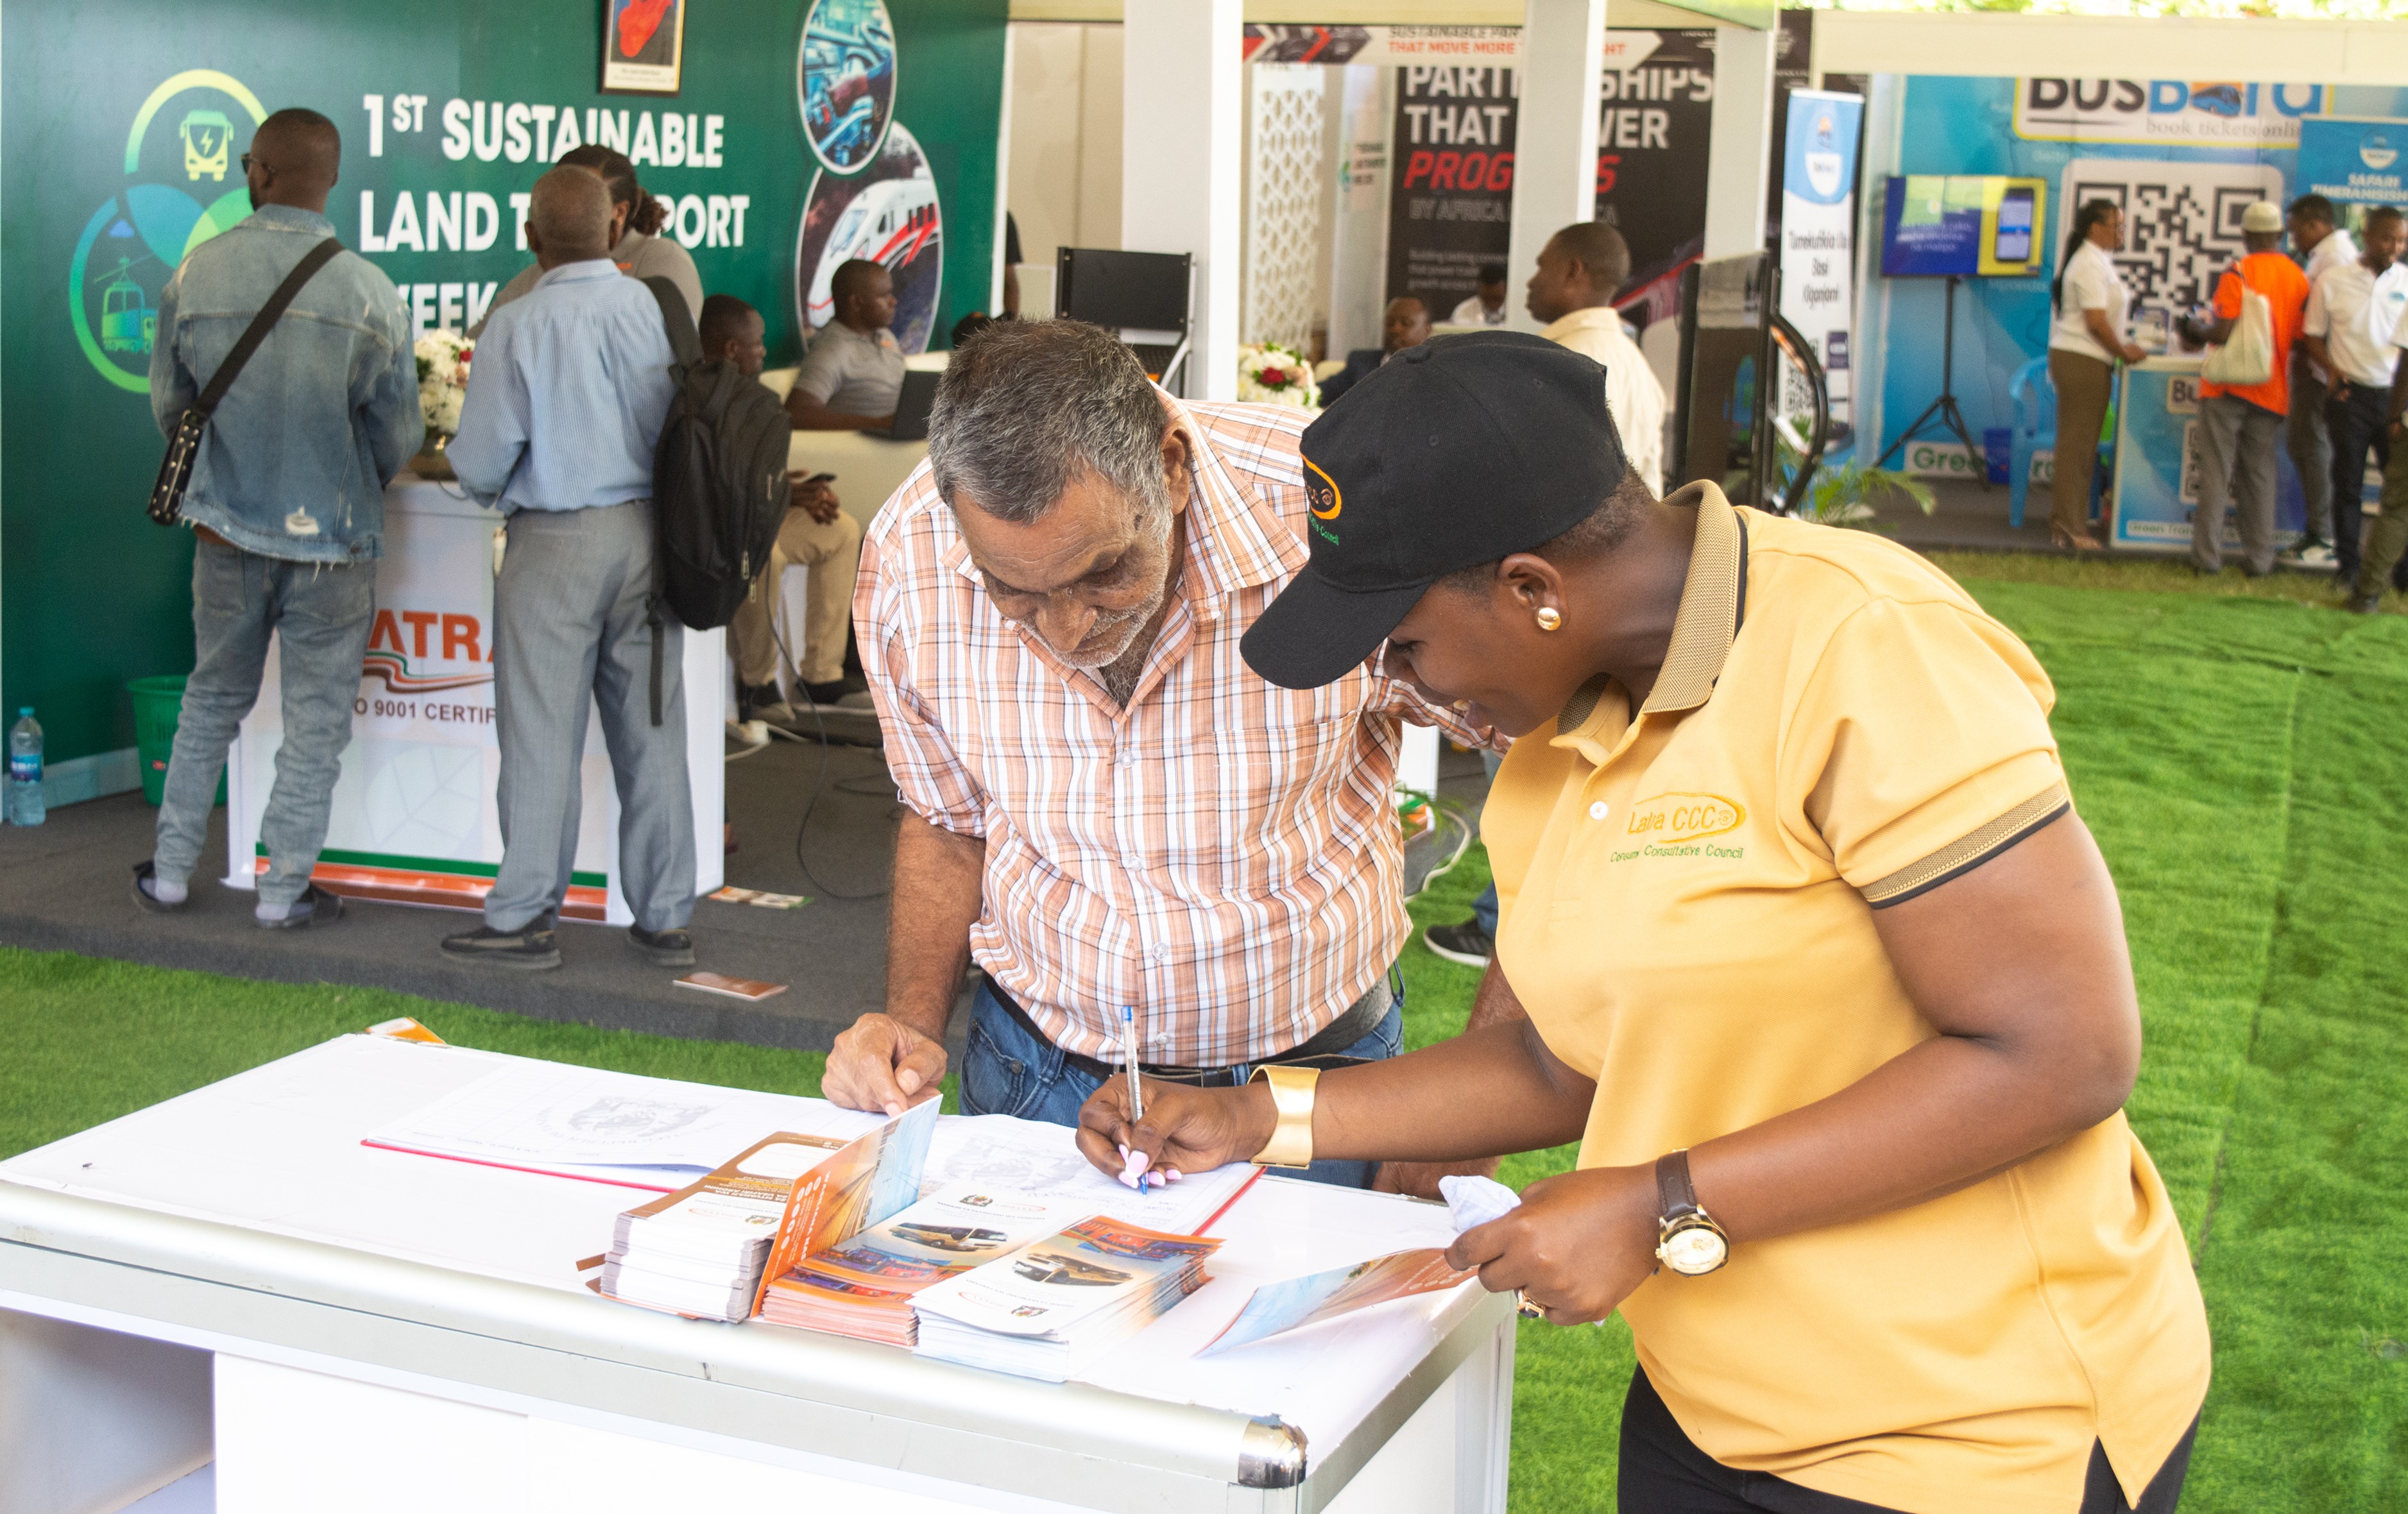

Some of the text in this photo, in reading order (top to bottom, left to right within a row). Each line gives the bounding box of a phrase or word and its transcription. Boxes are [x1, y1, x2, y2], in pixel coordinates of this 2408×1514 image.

[1388, 42, 1515, 54] THAT MOVE MORE
[364, 94, 724, 167] 1ST SUSTAINABLE
[1405, 105, 1509, 146] THAT
[2146, 120, 2300, 140] book tickets onli
[359, 190, 499, 252] LAND
[398, 281, 499, 338] EEK
[367, 608, 493, 663] ATR
[374, 699, 416, 719] 9001
[424, 702, 496, 724] CERTIF
[1672, 805, 1716, 831] CCC
[1644, 844, 1700, 857] Consultative
[1705, 844, 1744, 859] Council
[800, 1236, 811, 1261] NAS
